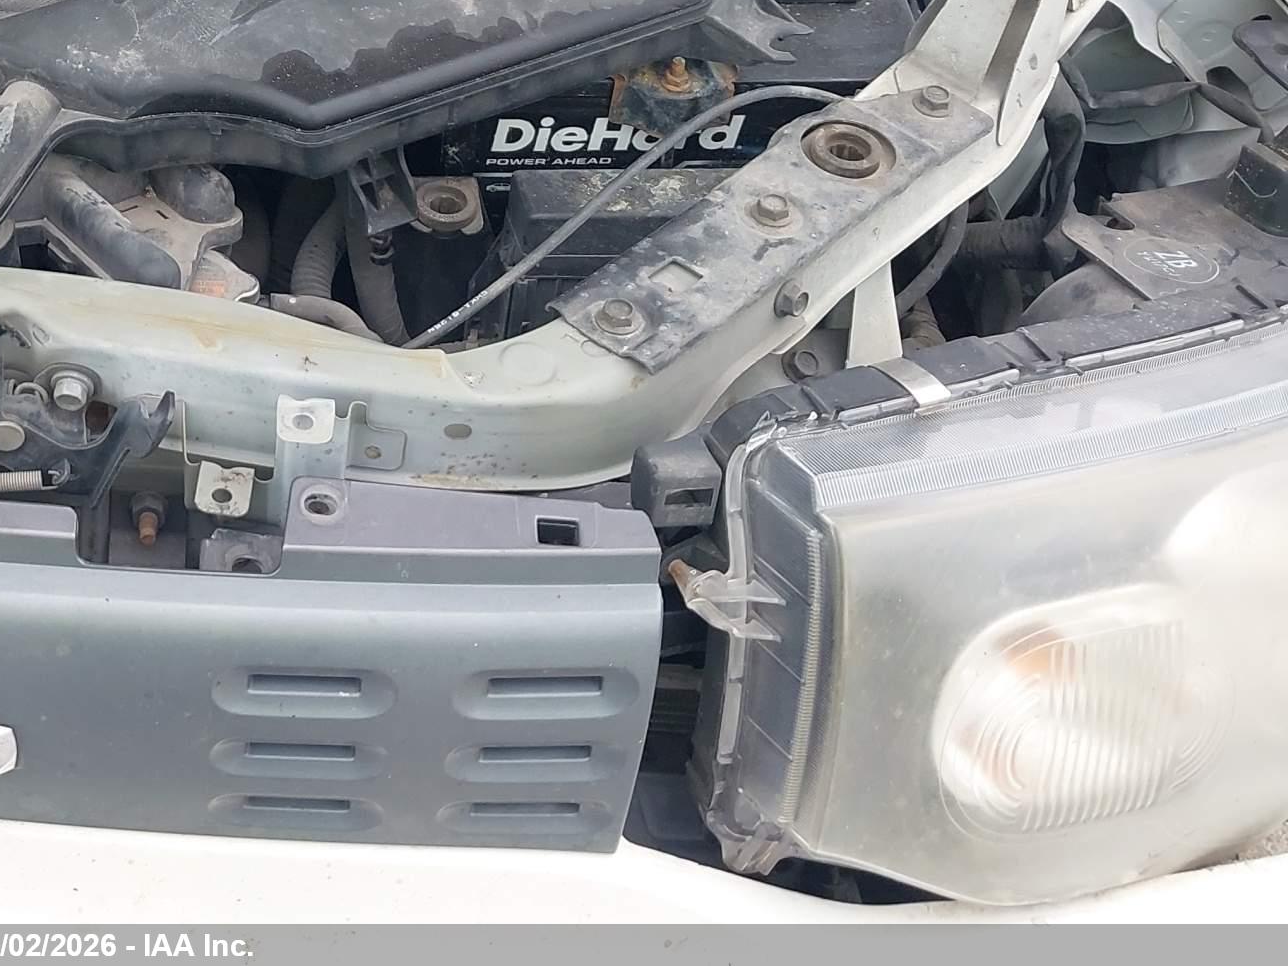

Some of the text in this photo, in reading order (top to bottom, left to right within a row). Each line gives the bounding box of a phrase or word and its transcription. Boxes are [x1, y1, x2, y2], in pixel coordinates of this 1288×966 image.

[485, 157, 612, 166] POWER AHEAD
[1152, 251, 1198, 268] ZB
